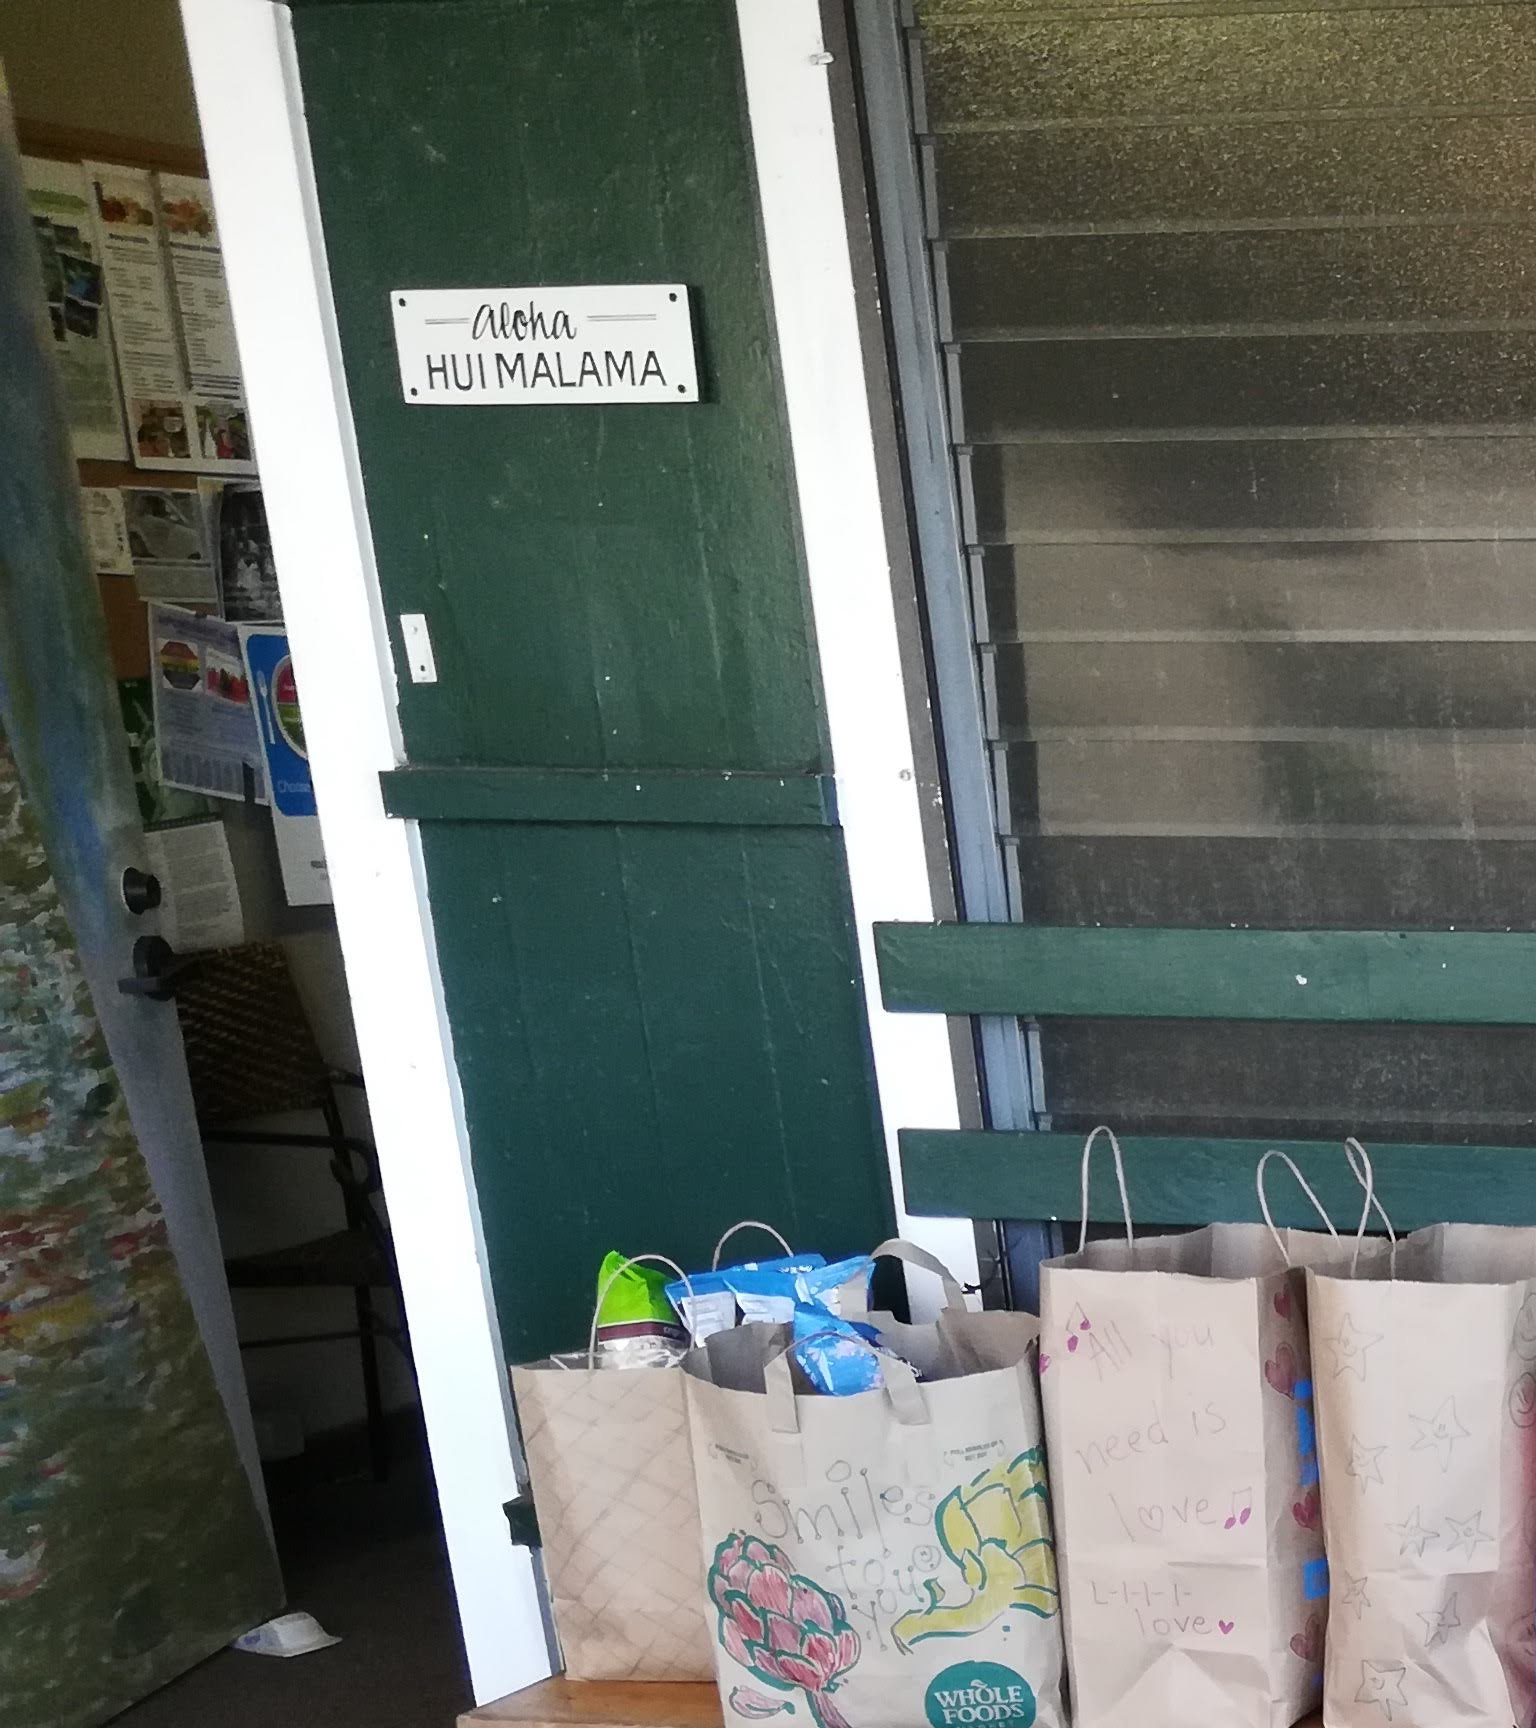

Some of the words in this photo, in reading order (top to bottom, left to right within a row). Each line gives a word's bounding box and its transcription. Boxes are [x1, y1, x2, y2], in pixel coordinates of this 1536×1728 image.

[425, 353, 488, 391] HUI
[495, 350, 668, 389] MALAMA
[1089, 1319, 1133, 1383] All
[1151, 1325, 1214, 1381] you
[1075, 1399, 1169, 1475] need
[1191, 1402, 1227, 1436] is
[751, 1459, 935, 1559] Smiles
[813, 1545, 887, 1600] to
[850, 1564, 925, 1651] you
[1134, 1607, 1213, 1637] love
[933, 1679, 1025, 1708] WHOLE
[941, 1703, 1025, 1725] FOODS
